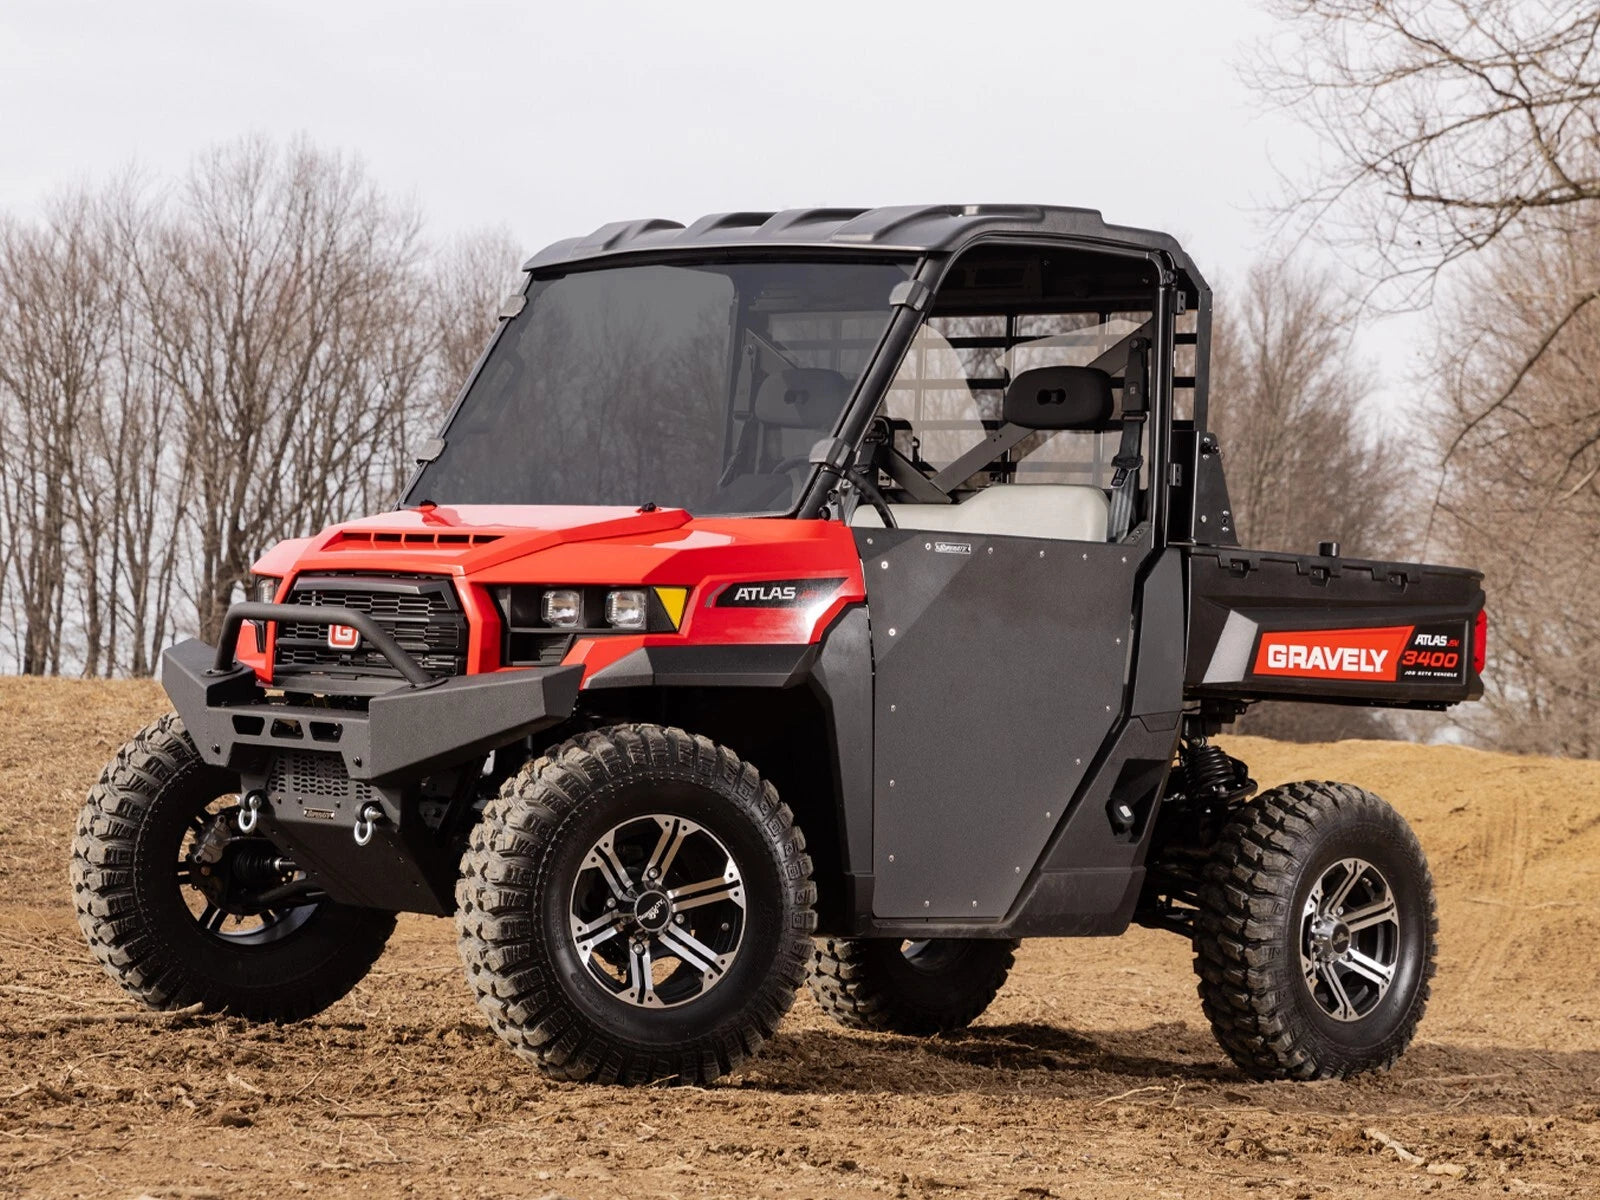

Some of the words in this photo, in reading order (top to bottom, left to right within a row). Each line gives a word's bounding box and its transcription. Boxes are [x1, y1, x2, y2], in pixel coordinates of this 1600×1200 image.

[734, 586, 797, 601] ATLAS
[1414, 633, 1447, 647] ATLAS
[1267, 643, 1389, 673] GRAVELY
[1401, 650, 1459, 668] 3400
